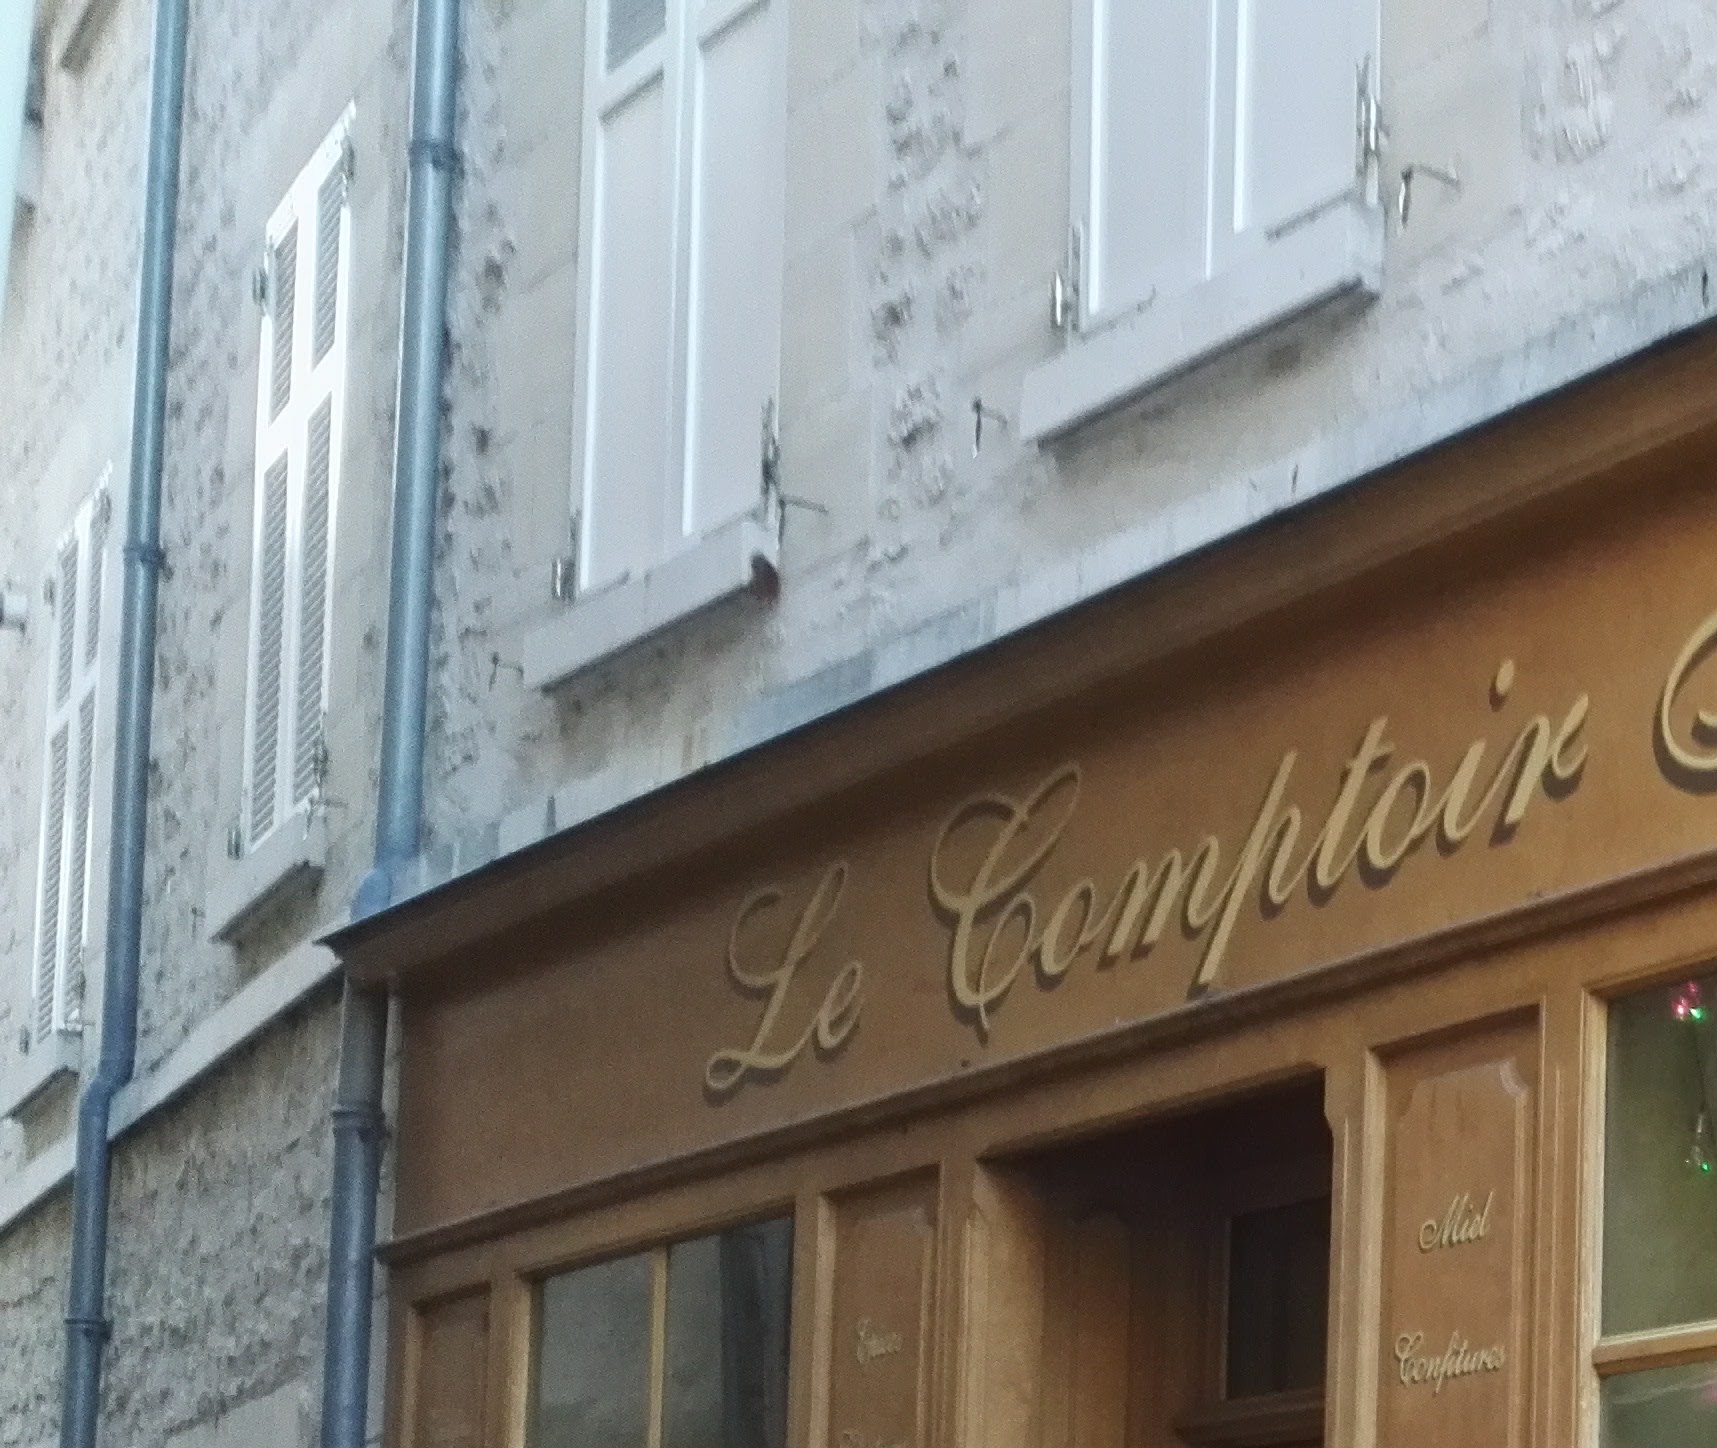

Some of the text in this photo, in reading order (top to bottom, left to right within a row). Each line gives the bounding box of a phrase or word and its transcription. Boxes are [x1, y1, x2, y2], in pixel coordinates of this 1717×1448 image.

[704, 860, 863, 1091] Le
[930, 659, 1590, 1028] Comptoir
[1395, 1330, 1506, 1395] Confitures
